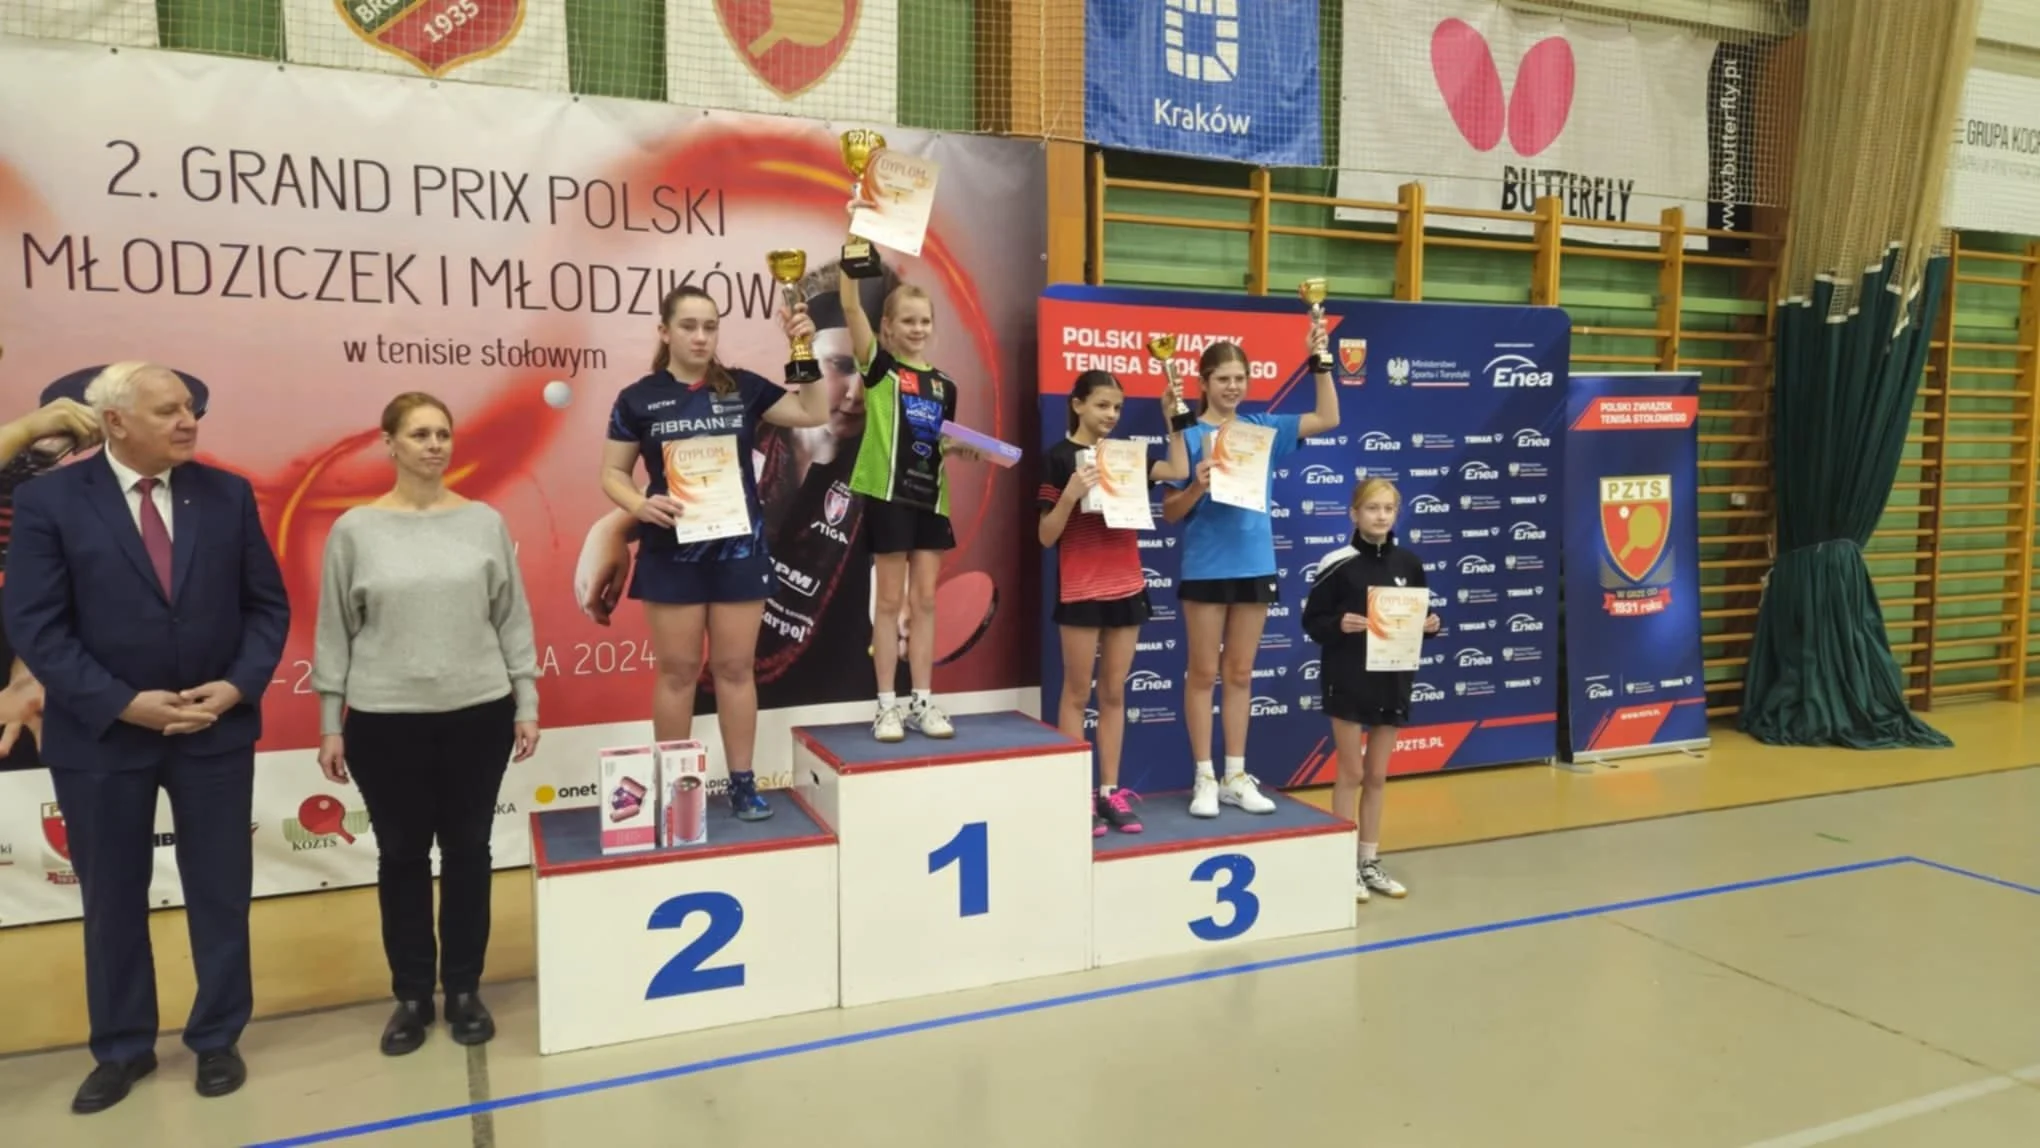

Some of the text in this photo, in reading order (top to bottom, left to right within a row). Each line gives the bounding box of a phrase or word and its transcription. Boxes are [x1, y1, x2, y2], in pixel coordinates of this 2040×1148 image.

[424, 0, 480, 43] 1935
[1154, 98, 1250, 135] Kraków
[1967, 118, 2008, 150] GRUPA
[105, 139, 726, 238] 2. GRAND PRIX POLSKI
[1501, 165, 1635, 223] BUTTERFLY
[21, 231, 422, 306] MŁODZICZEK
[439, 254, 449, 307] I
[1063, 326, 1142, 349] POLSKI
[343, 334, 608, 379] w tenisie stołowym
[1063, 352, 1142, 375] TENISA
[1493, 367, 1554, 388] Enea
[1600, 402, 1632, 413] POLSKI
[650, 417, 726, 437] FIBRAIN
[1364, 439, 1401, 451] Enea
[1517, 436, 1551, 447] Enea
[1306, 472, 1344, 484] Enea
[1464, 469, 1499, 480] Enea
[1608, 480, 1662, 499] PZTS
[1415, 502, 1450, 514] Enea
[811, 520, 849, 545] STIGA
[1514, 529, 1547, 540] Enea
[1462, 563, 1496, 574] Enea
[1144, 577, 1173, 588] nea
[763, 611, 806, 643] arpol
[1511, 621, 1544, 632] Enea
[574, 639, 658, 676] 2024
[1460, 655, 1493, 666] Enea
[1131, 679, 1172, 691] Enea
[1411, 690, 1445, 702] Enea
[1250, 703, 1288, 716] Enea
[558, 783, 598, 798] onet
[292, 838, 338, 851] KOZTS
[928, 821, 989, 918] 1
[1187, 853, 1261, 941] 3
[644, 891, 746, 1000] 2
